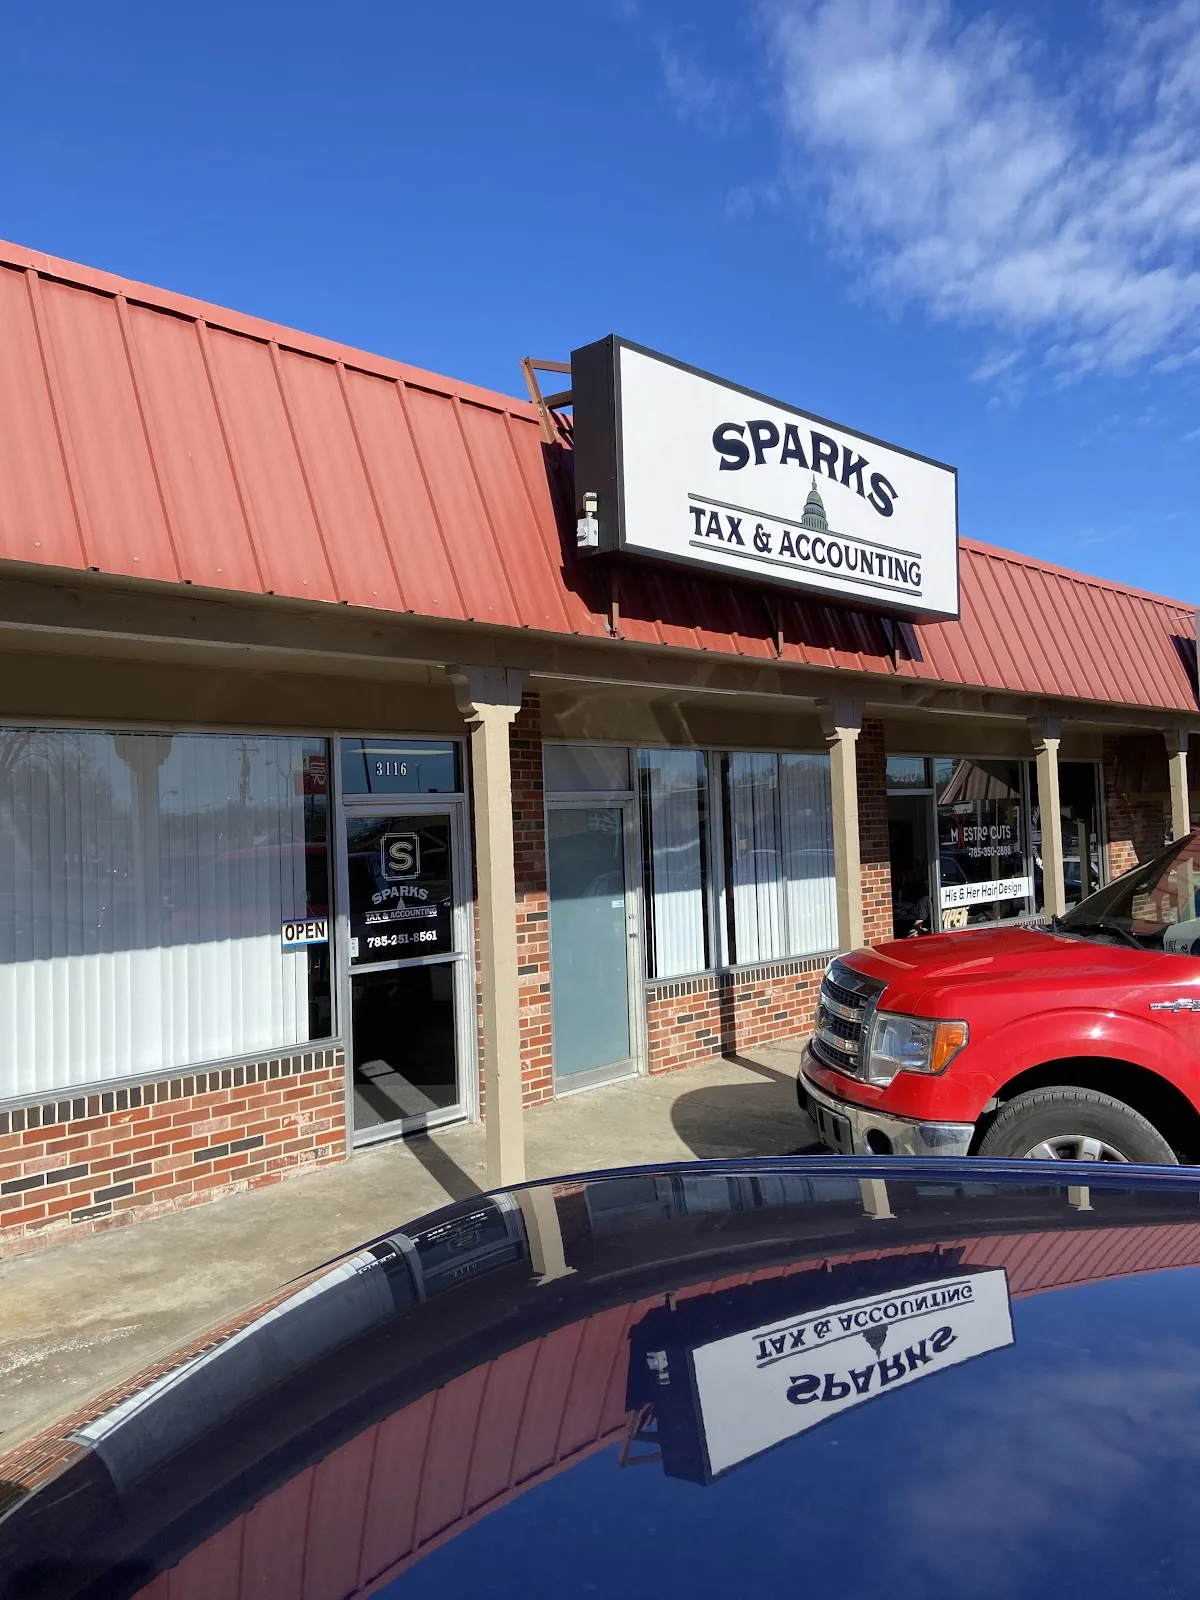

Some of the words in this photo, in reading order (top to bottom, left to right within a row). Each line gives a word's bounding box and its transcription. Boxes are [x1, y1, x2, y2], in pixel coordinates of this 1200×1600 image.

[712, 419, 899, 518] SPARKS
[689, 505, 746, 546] TAX
[753, 523, 772, 554] &
[778, 530, 922, 587] ACCOUNTING
[376, 762, 407, 776] 3116
[990, 825, 1012, 840] CUTS
[388, 841, 414, 871] S
[371, 885, 429, 905] SPARKS
[944, 890, 957, 903] His
[959, 888, 965, 901] &
[966, 887, 980, 899] Her
[981, 884, 998, 897] Hair
[998, 882, 1022, 896] Design
[365, 912, 382, 922] TAX
[382, 912, 390, 920] &
[390, 907, 438, 919] ACCOUNTING
[285, 921, 325, 941] OPEN
[366, 929, 438, 949] 785-251-8561
